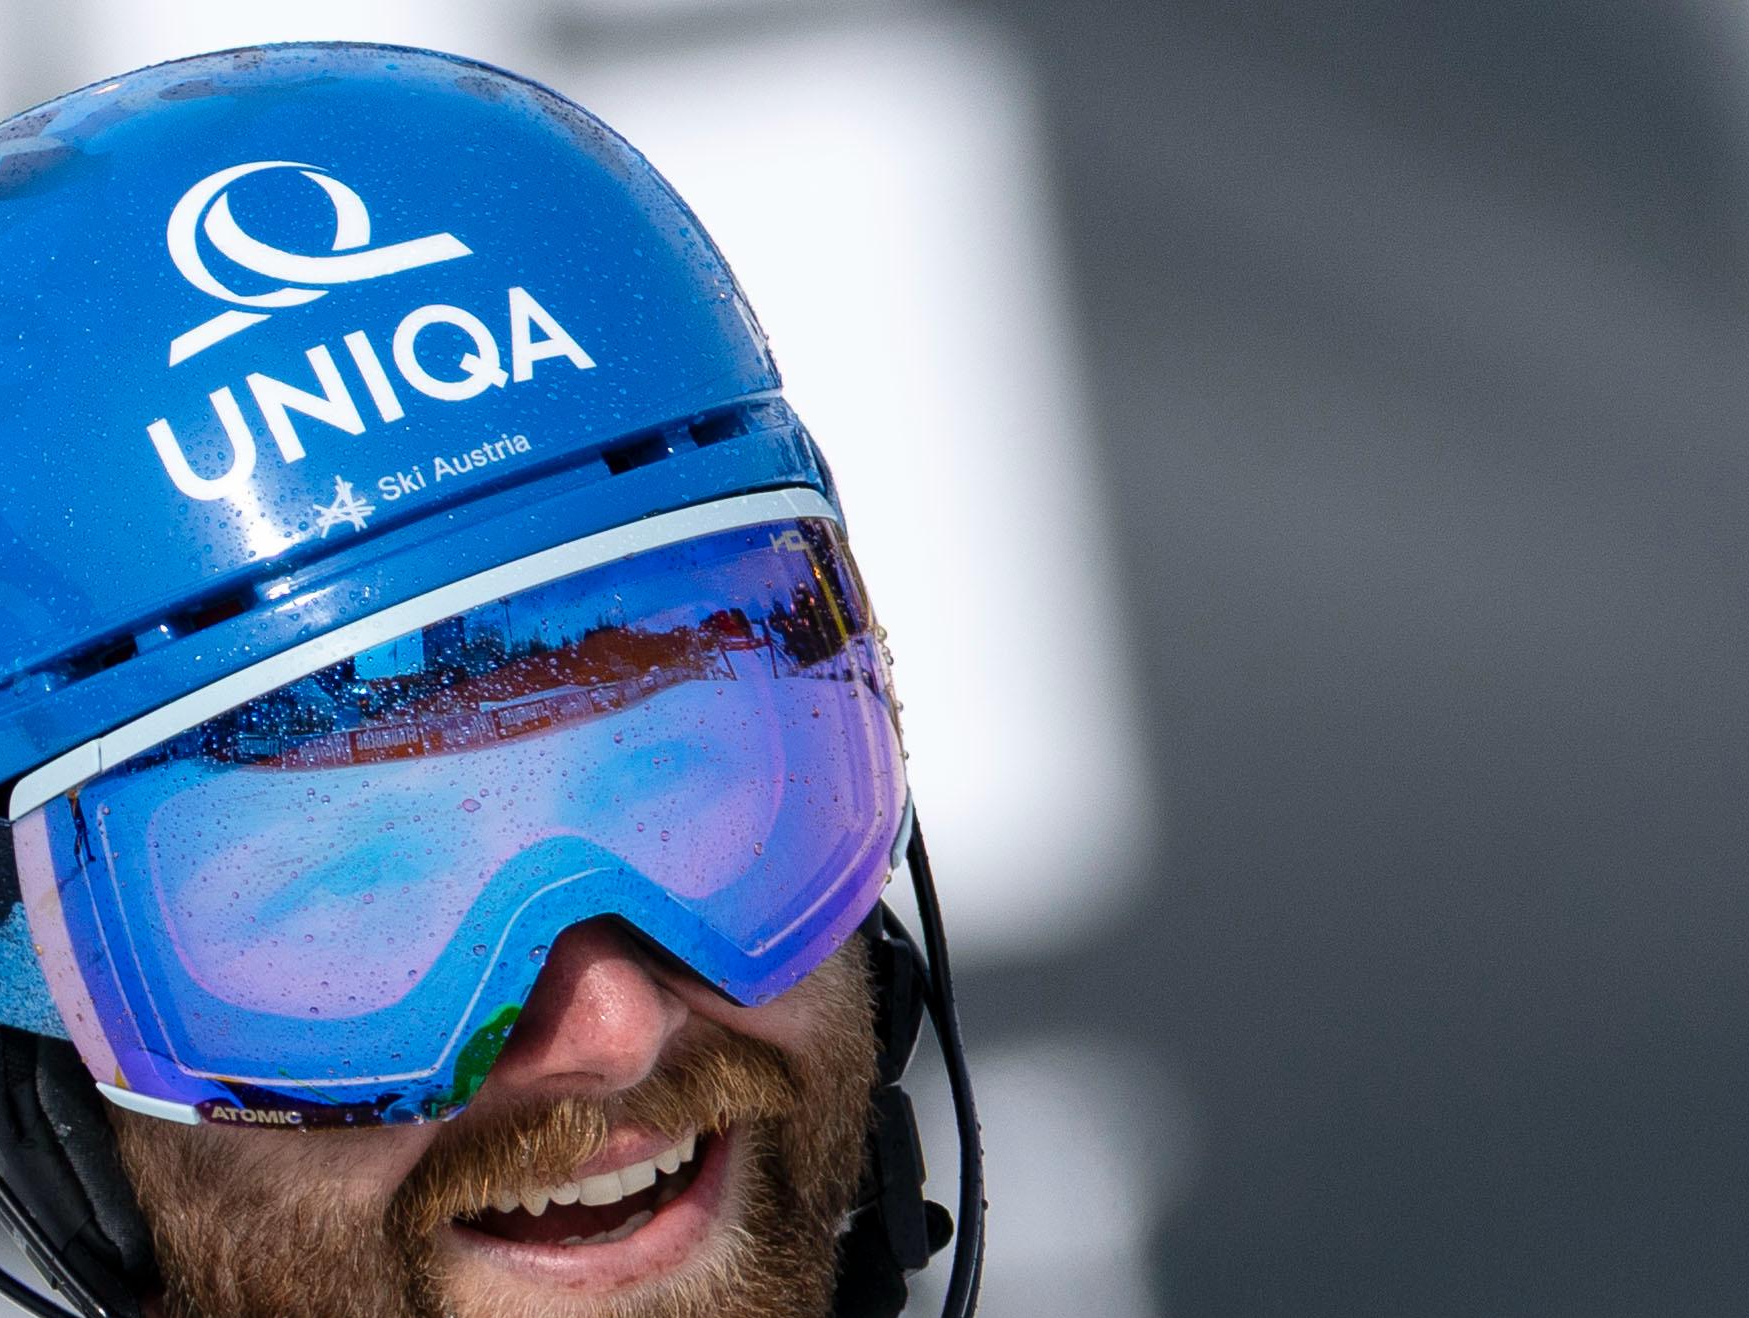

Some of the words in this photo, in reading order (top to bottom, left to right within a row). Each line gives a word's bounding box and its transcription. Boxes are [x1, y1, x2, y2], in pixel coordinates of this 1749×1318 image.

[148, 286, 596, 502] UNIQA
[377, 465, 426, 501] Ski
[433, 432, 533, 483] Austria
[210, 1105, 302, 1126] ATOMIC
